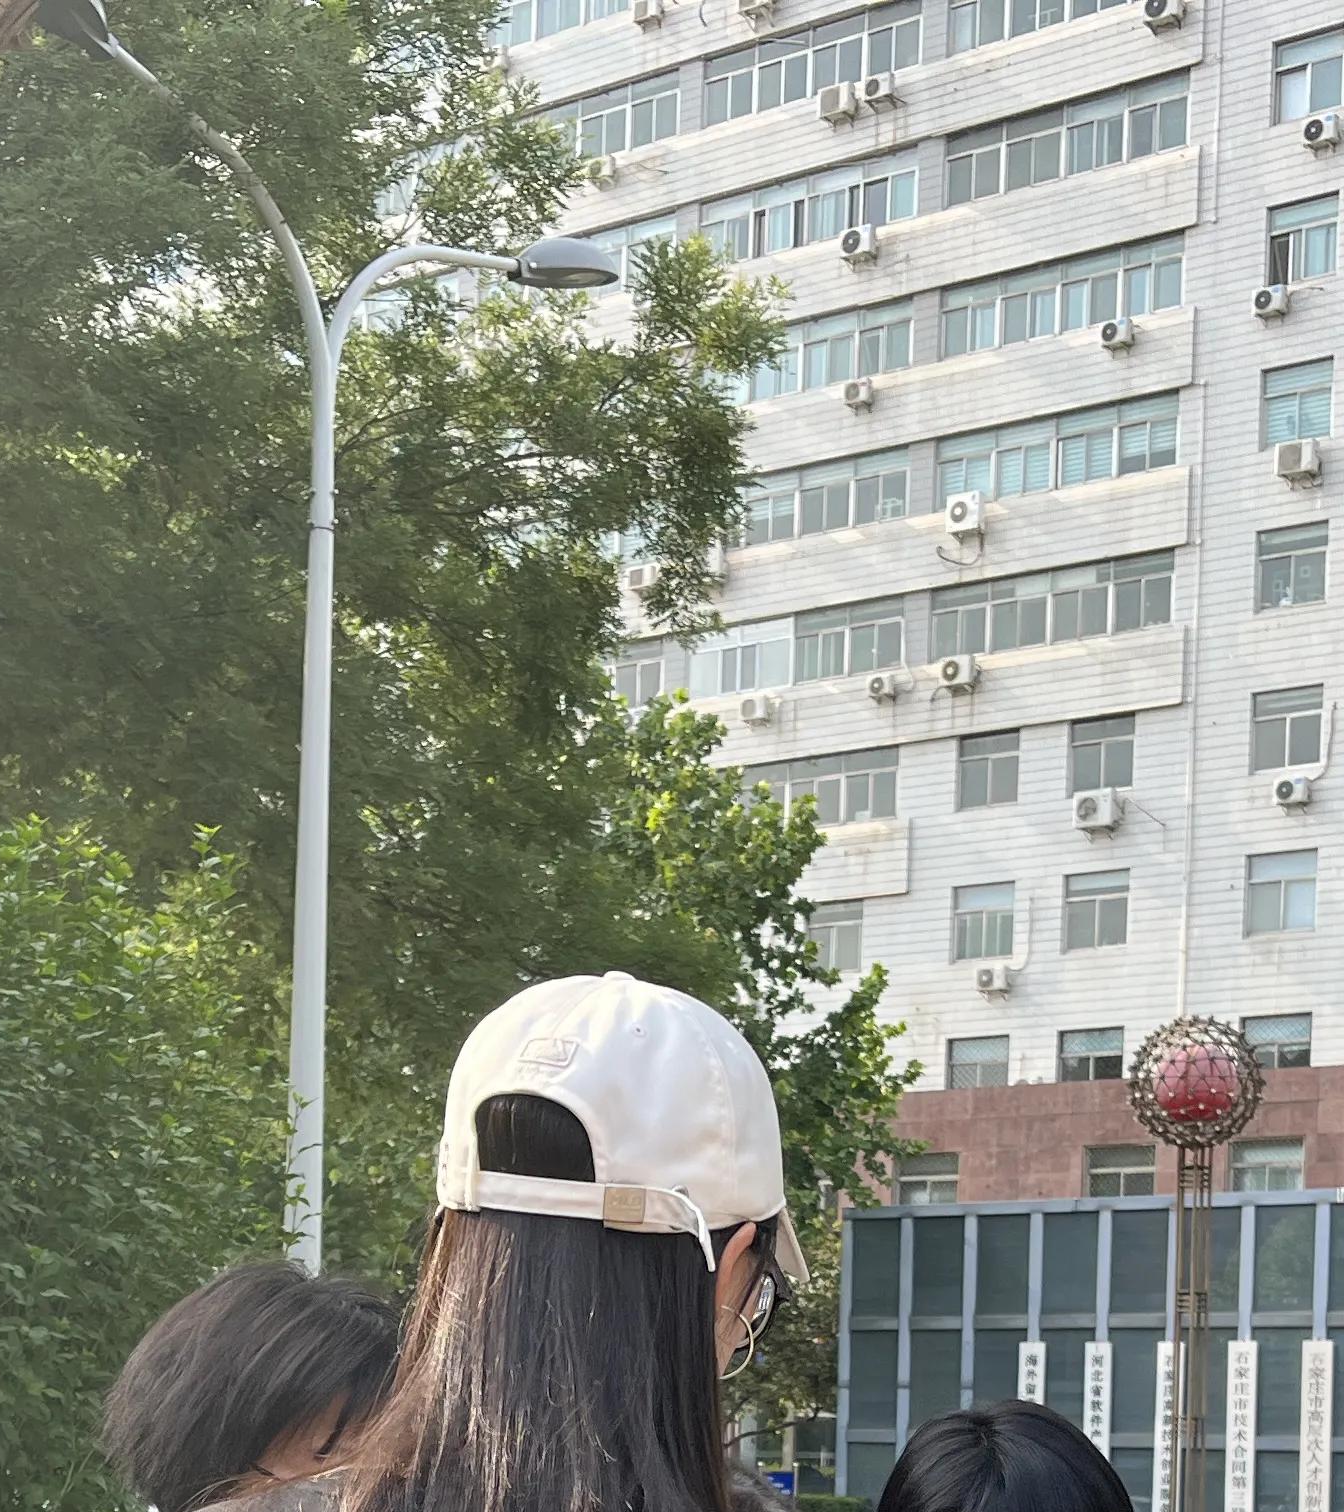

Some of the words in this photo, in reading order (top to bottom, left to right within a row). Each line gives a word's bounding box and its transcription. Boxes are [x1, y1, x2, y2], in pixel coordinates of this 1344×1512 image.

[1090, 1353, 1105, 1450] 河北省软件产
